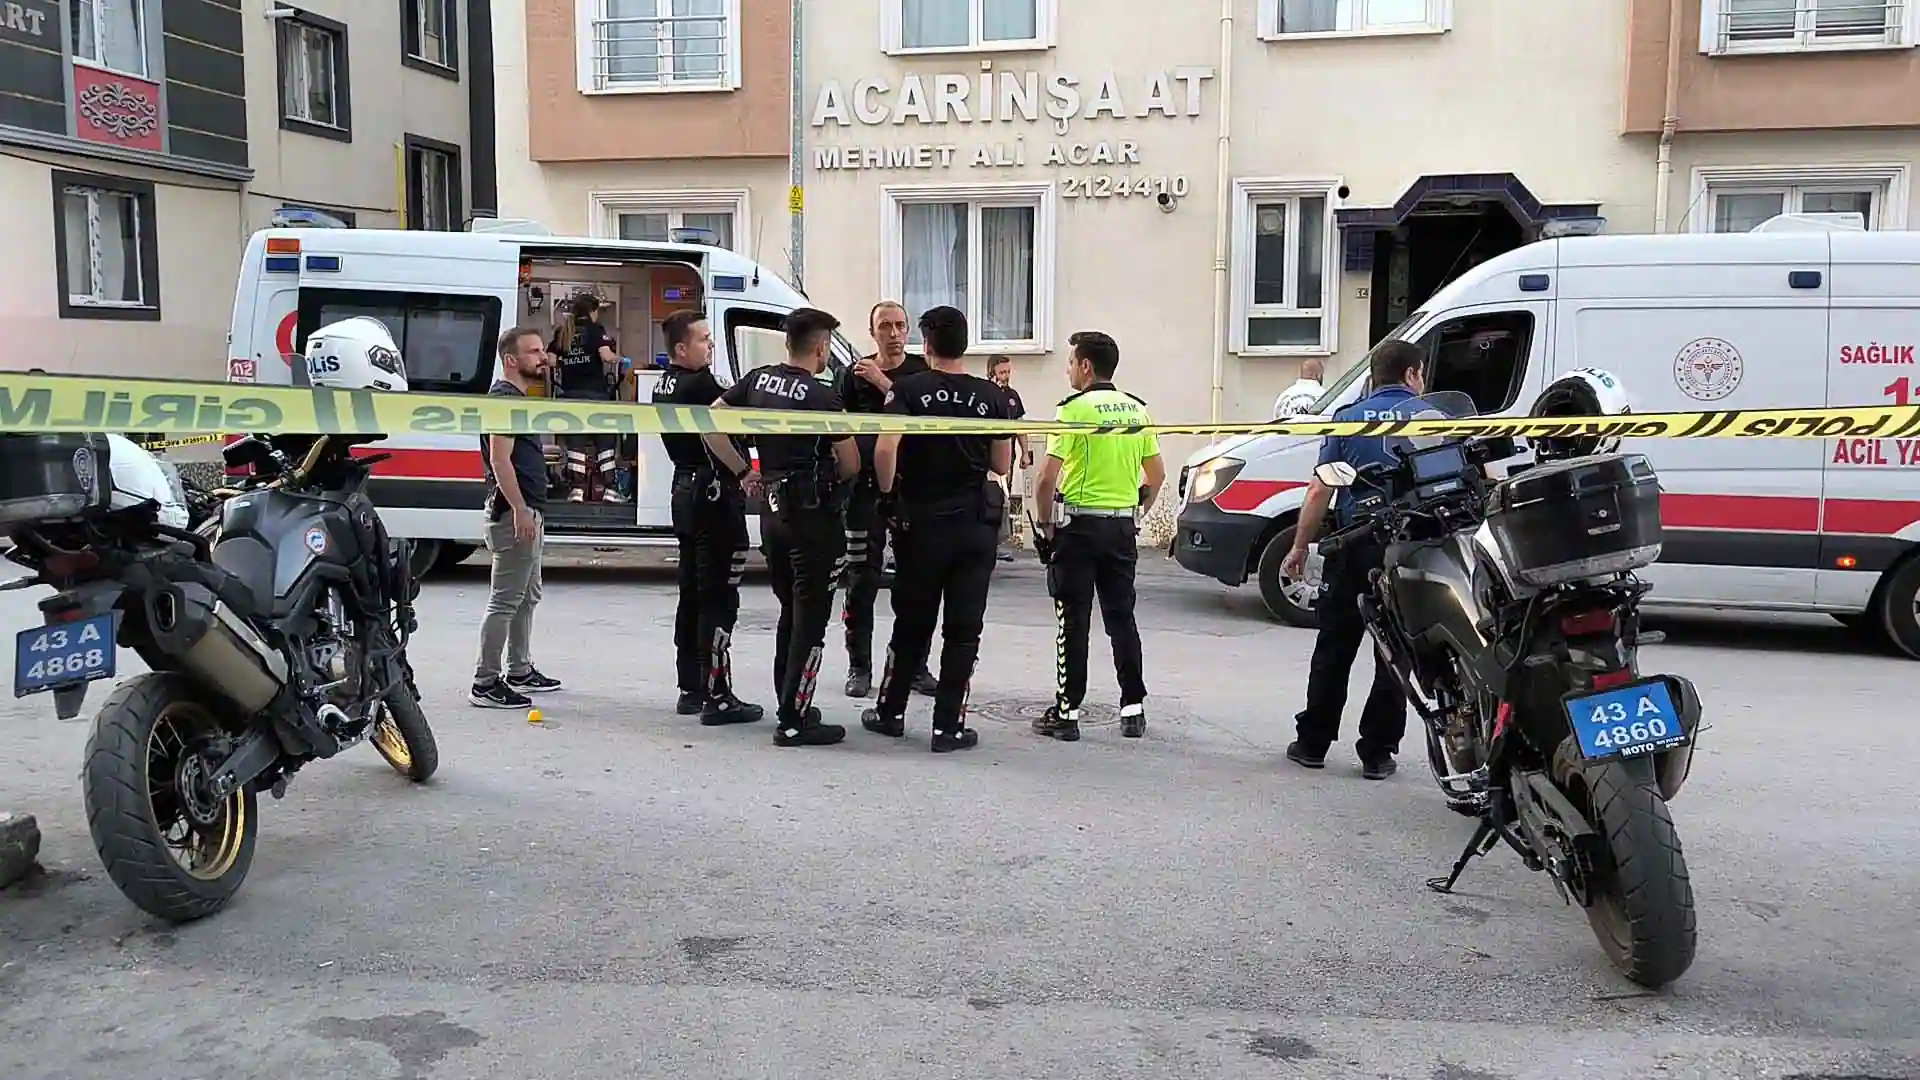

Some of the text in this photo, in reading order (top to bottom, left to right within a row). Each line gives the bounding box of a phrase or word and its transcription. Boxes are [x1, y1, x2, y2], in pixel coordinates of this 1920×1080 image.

[0, 1, 46, 36] RT
[814, 134, 1141, 170] MEHMET ALİ ACAR
[1062, 175, 1190, 198] 2124410
[1840, 341, 1915, 364] SAĞLIK
[754, 372, 809, 401] POLIS
[30, 623, 101, 652] 43 A
[27, 649, 104, 679] 4868
[1591, 696, 1661, 724] 43 A
[1595, 718, 1667, 747] 4860
[1621, 743, 1655, 756] MOTO
